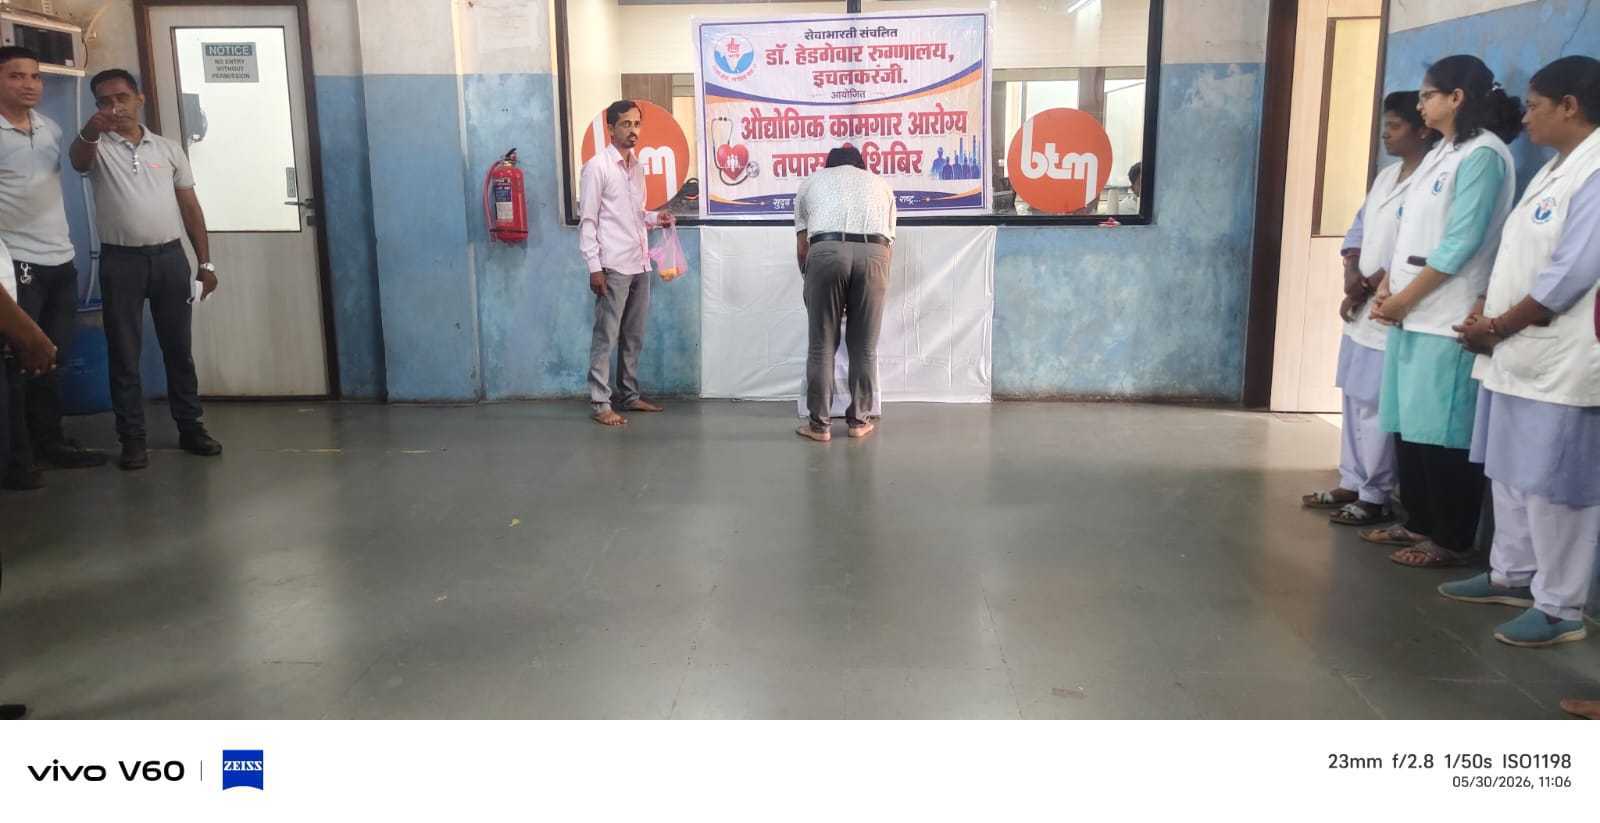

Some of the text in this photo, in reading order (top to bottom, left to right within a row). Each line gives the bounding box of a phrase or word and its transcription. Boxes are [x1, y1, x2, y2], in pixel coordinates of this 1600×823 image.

[804, 26, 898, 40] सेवाभारती संचलित
[209, 46, 250, 55] NOTICE
[765, 44, 790, 66] डॉ.
[795, 42, 864, 65] हेडगेवार
[867, 43, 955, 63] रुग्णालय,
[812, 63, 909, 88] इचलकरंजी.
[831, 88, 866, 99] आयोजित
[741, 103, 968, 140] औद्योगिक कामगार आरोग्य
[862, 141, 923, 175] शिबिर
[1021, 117, 1098, 206] btm
